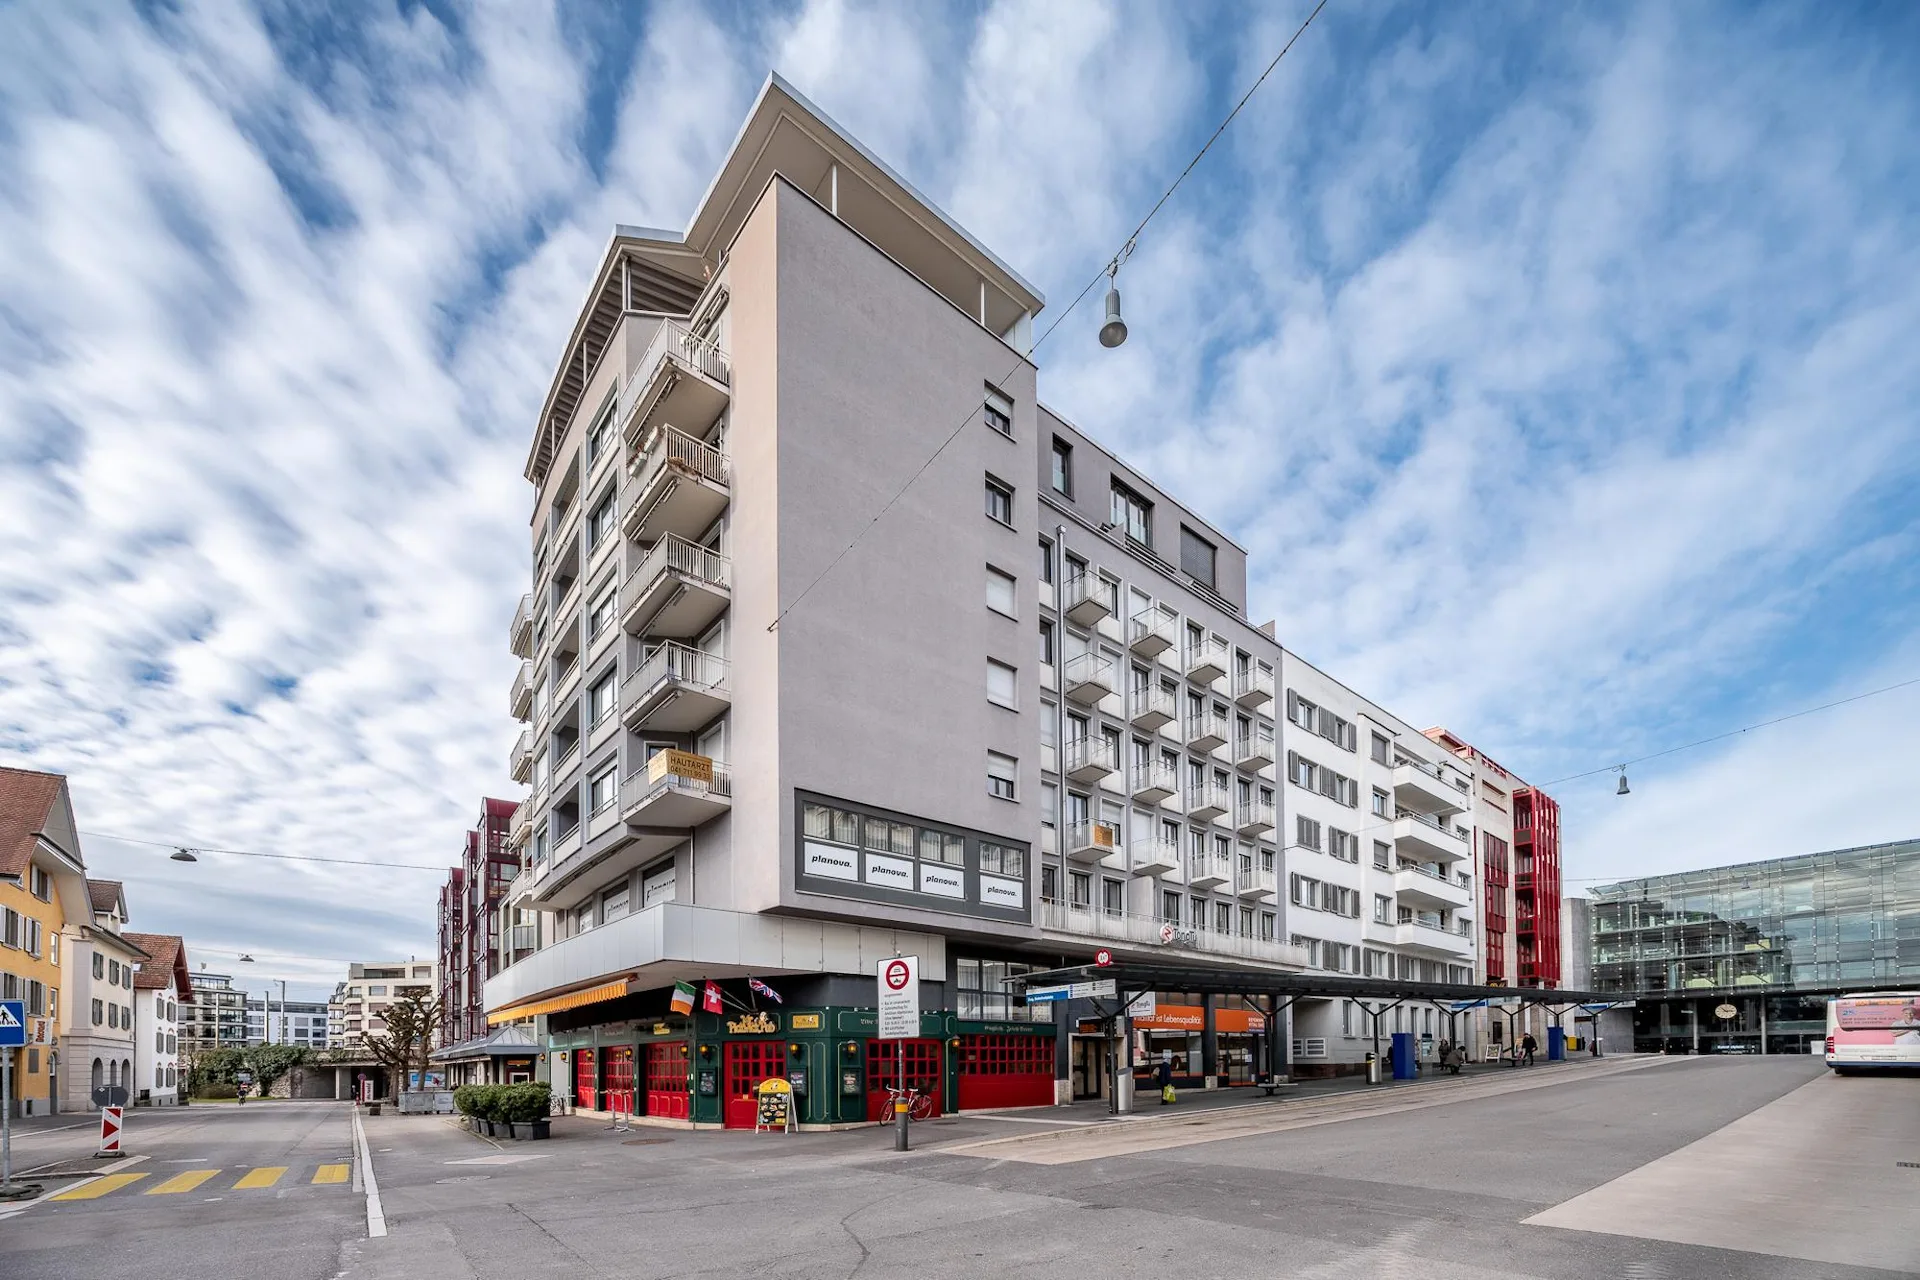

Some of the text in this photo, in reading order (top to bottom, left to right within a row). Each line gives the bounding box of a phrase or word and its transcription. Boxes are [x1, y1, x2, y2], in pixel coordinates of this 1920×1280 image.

[670, 756, 710, 772] HAUTARZT
[670, 766, 680, 774] 041
[811, 854, 852, 868] planova.
[872, 865, 909, 878] planova.
[925, 875, 960, 887] planova.
[987, 886, 1017, 897] planova.
